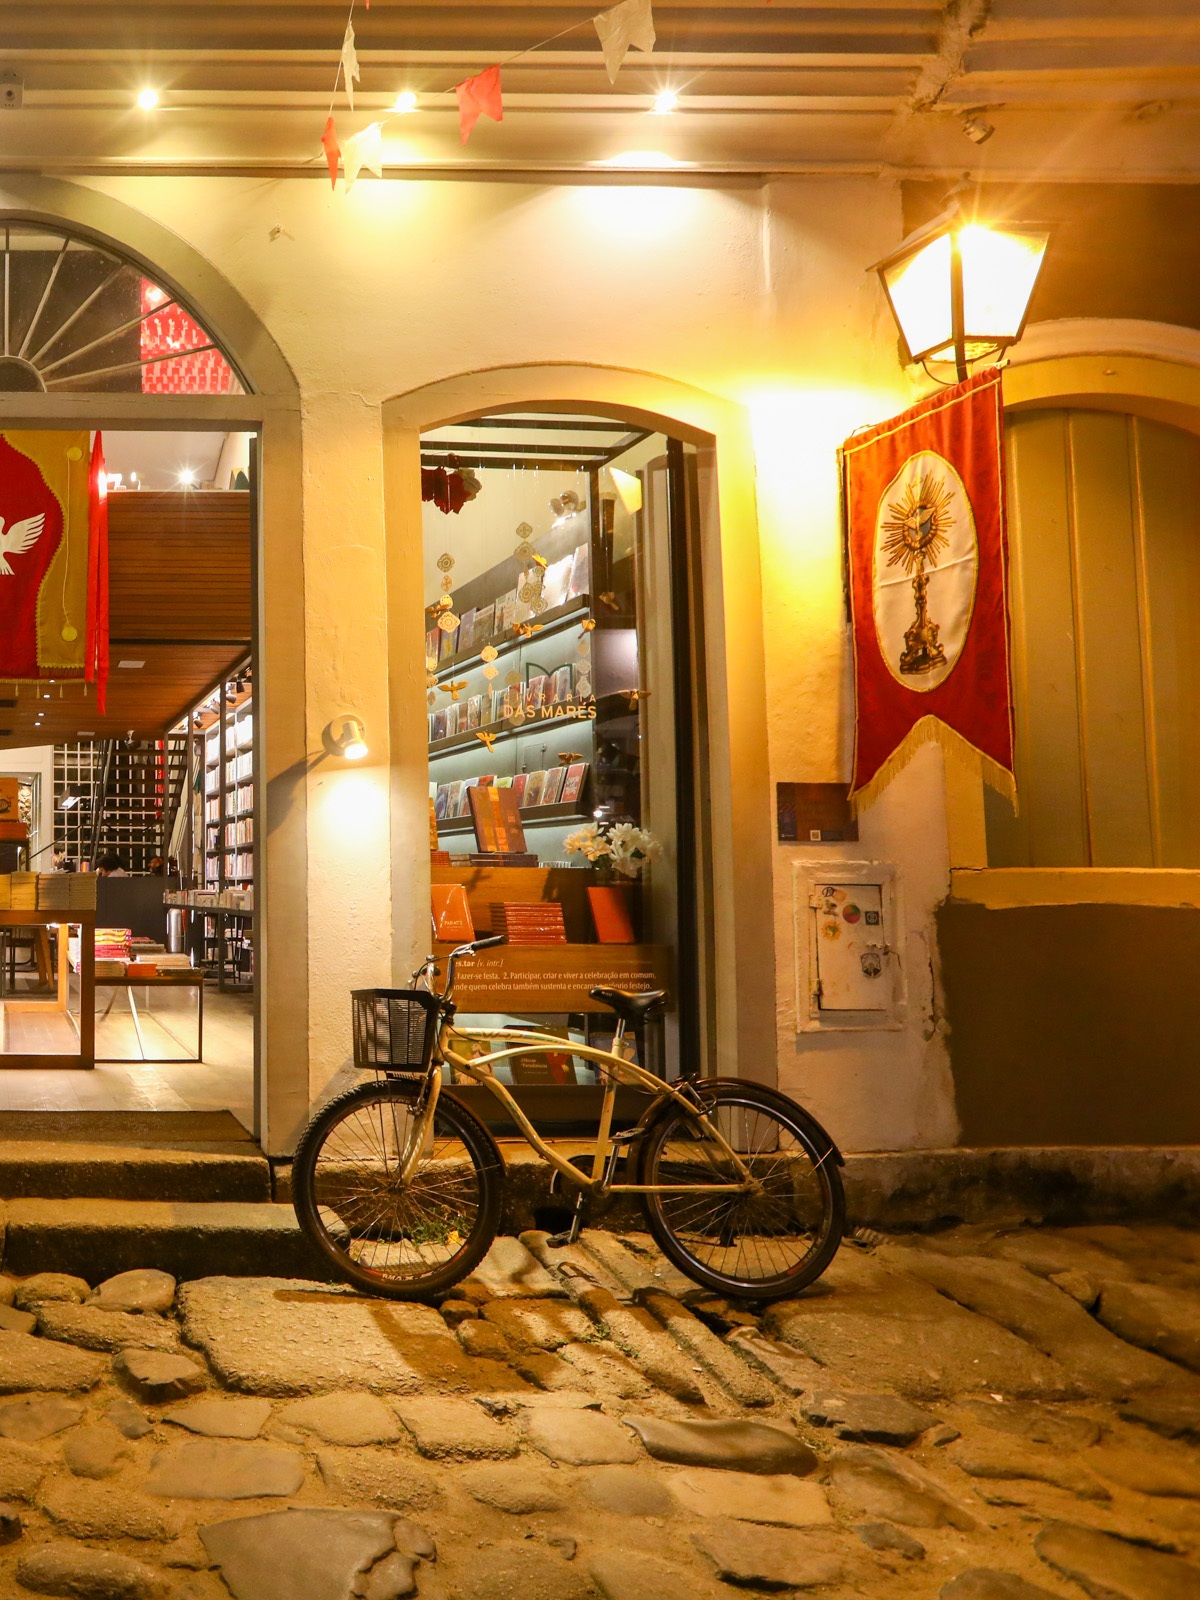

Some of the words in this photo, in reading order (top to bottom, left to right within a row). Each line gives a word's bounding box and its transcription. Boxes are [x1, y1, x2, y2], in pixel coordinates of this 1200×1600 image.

[503, 693, 597, 703] LIVRARIA
[503, 704, 536, 719] DAS
[541, 702, 597, 719] MARÉS
[457, 972, 482, 980] Fazer-se
[483, 972, 500, 980] festa.
[503, 972, 509, 980] 2.
[510, 972, 542, 981] Participar,
[543, 972, 557, 980] criar
[563, 972, 578, 980] viver
[584, 972, 618, 981] celebração
[468, 983, 487, 992] quem
[488, 982, 511, 990] celebra
[513, 982, 539, 990] também
[540, 982, 567, 990] sustenta
[629, 982, 652, 991] festejo.
